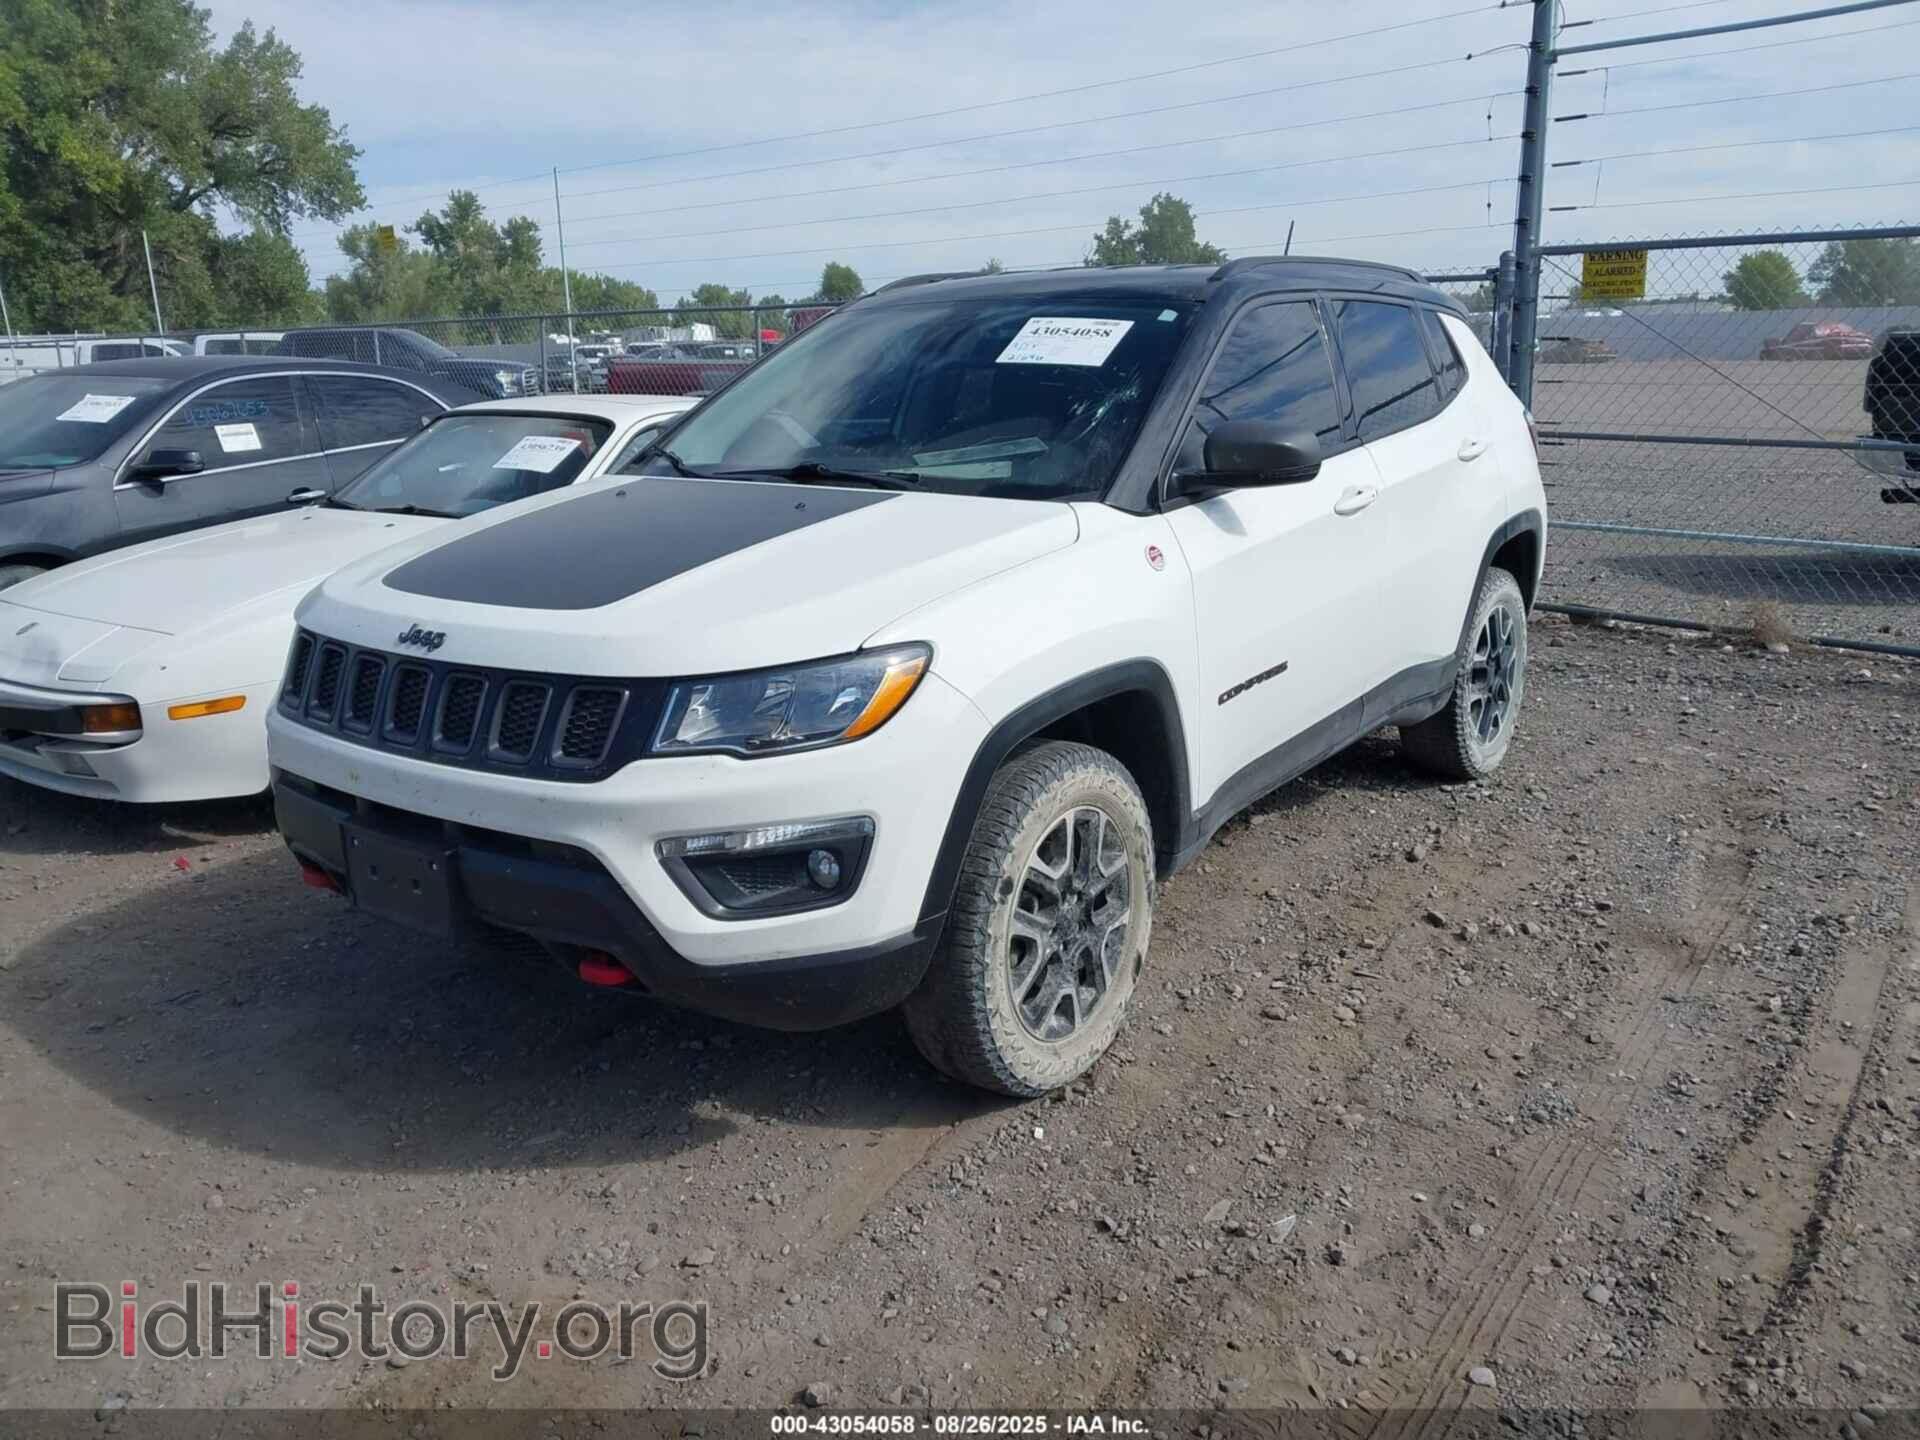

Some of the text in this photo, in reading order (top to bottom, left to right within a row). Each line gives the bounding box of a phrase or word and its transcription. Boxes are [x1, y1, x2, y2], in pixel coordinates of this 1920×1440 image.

[1588, 249, 1643, 262] WARNING
[1028, 326, 1113, 338] 43054058
[398, 623, 446, 652] Jeep
[1218, 660, 1288, 706] COMPASS
